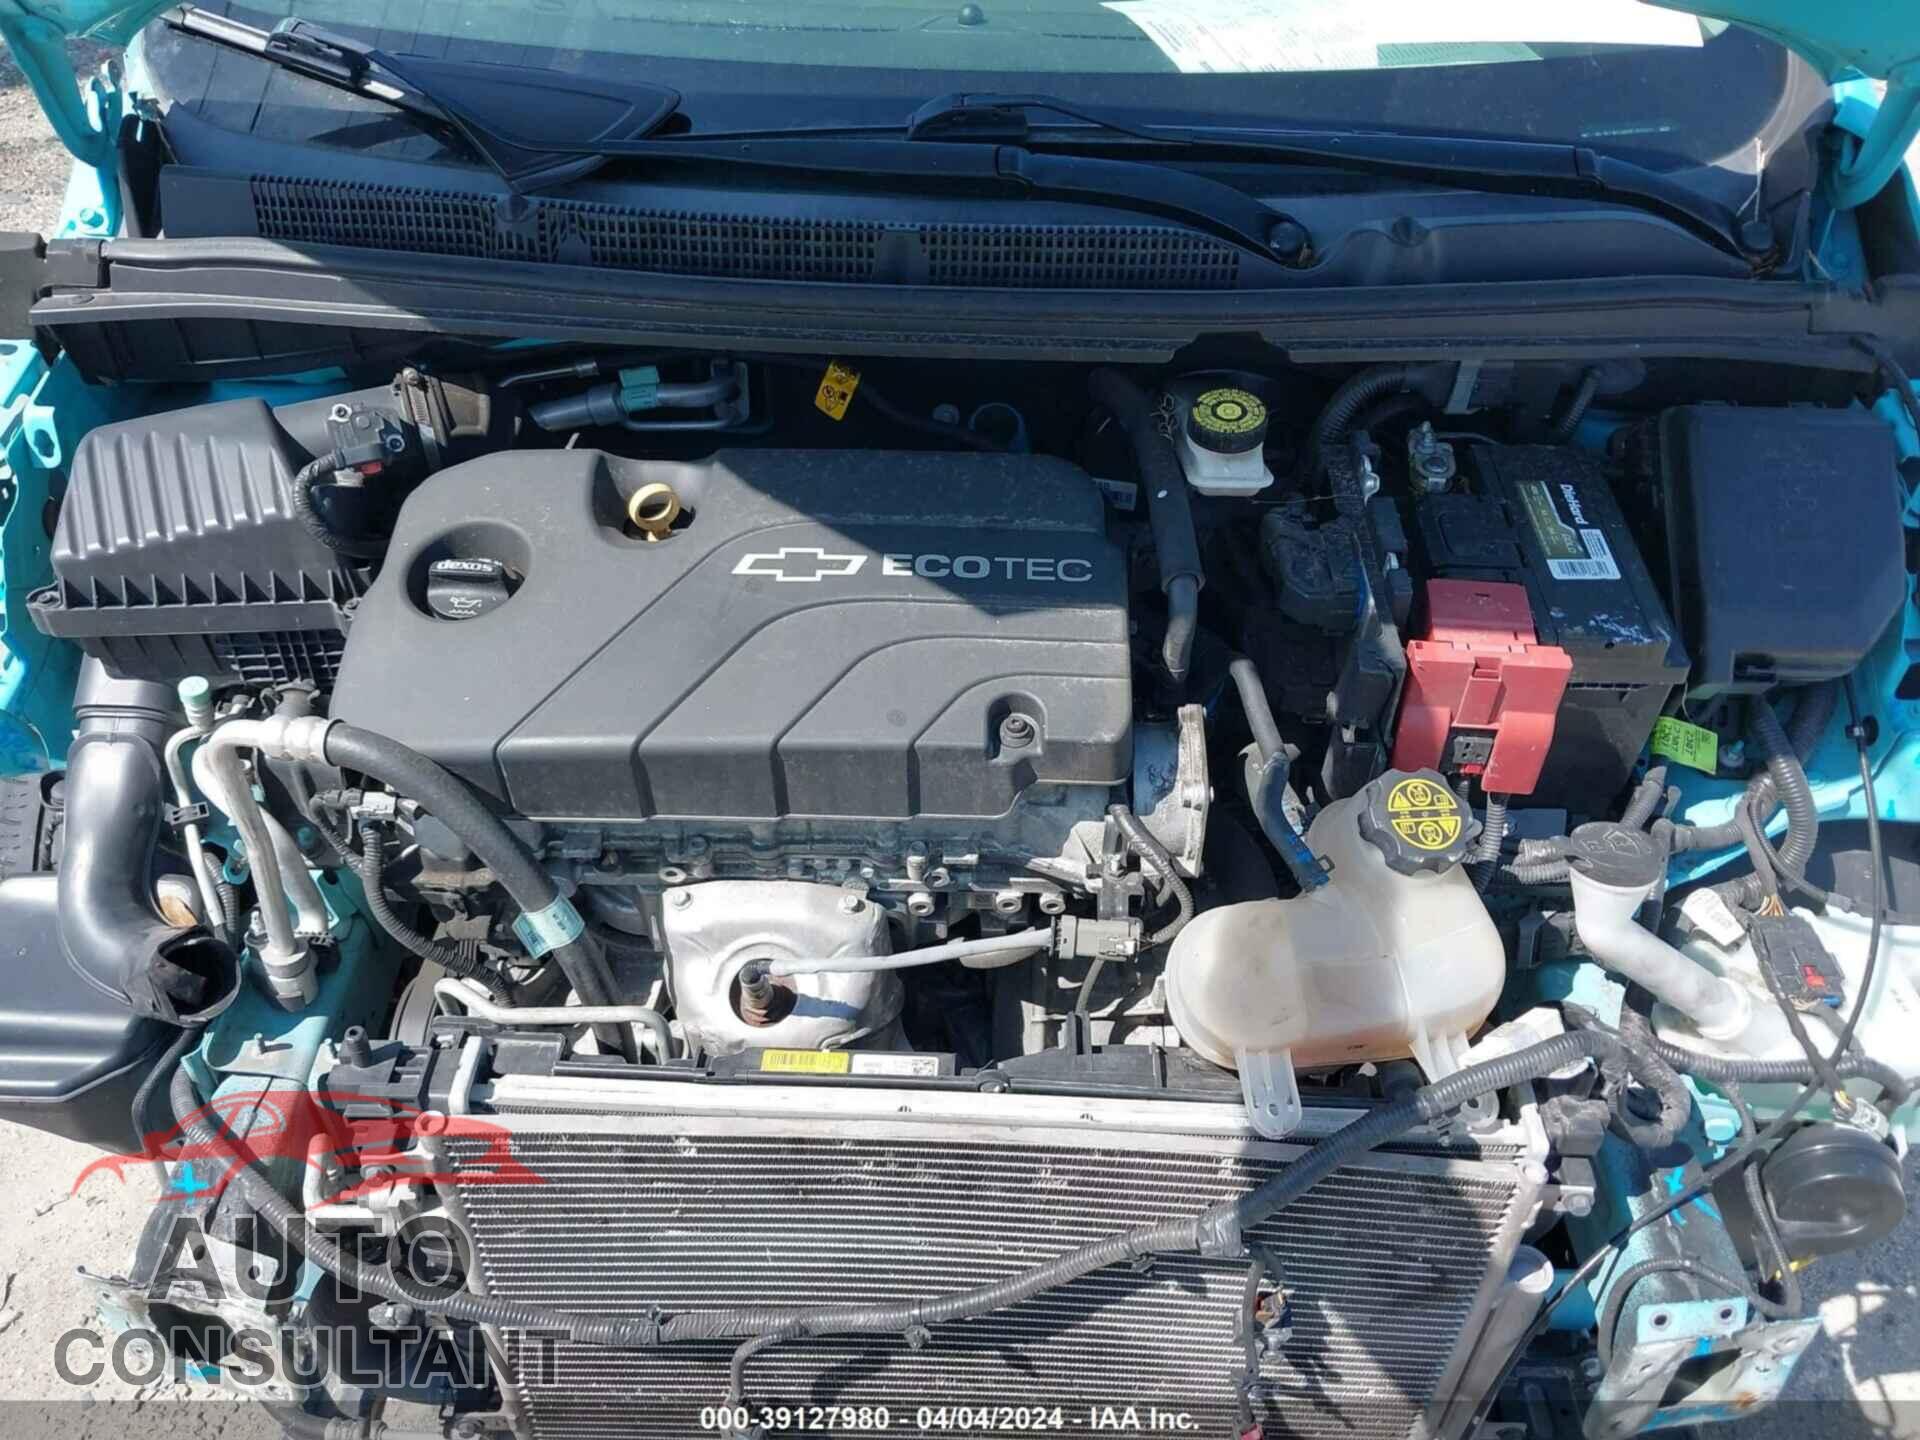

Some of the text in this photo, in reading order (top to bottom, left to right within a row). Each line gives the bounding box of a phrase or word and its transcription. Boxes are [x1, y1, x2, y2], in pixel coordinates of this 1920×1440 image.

[1560, 484, 1588, 525] DieHard
[436, 559, 493, 572] dexos
[882, 553, 1093, 582] ECOTEC
